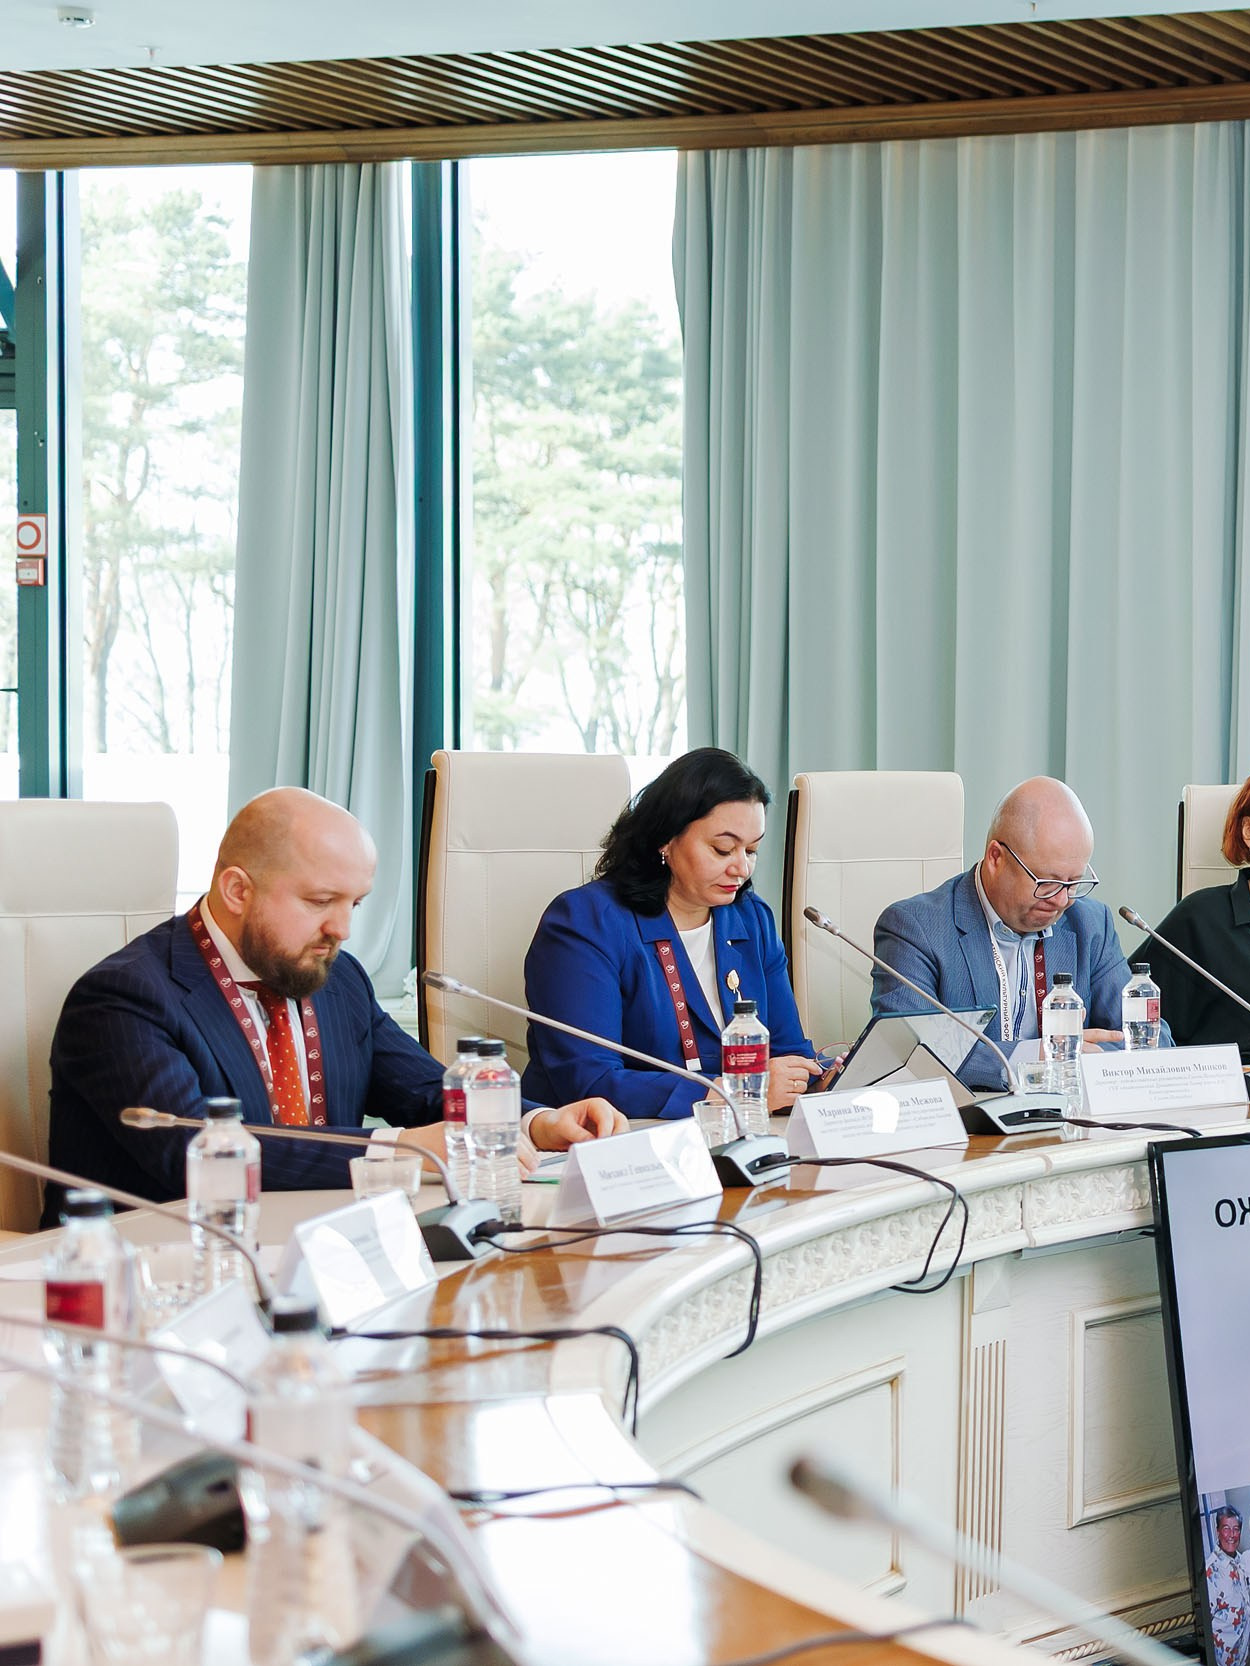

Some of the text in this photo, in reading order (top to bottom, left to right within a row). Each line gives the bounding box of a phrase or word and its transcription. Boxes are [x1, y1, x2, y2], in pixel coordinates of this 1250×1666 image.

[1101, 1067, 1135, 1078] Виктор
[1136, 1064, 1192, 1075] Михайлович
[817, 1107, 852, 1118] Марина
